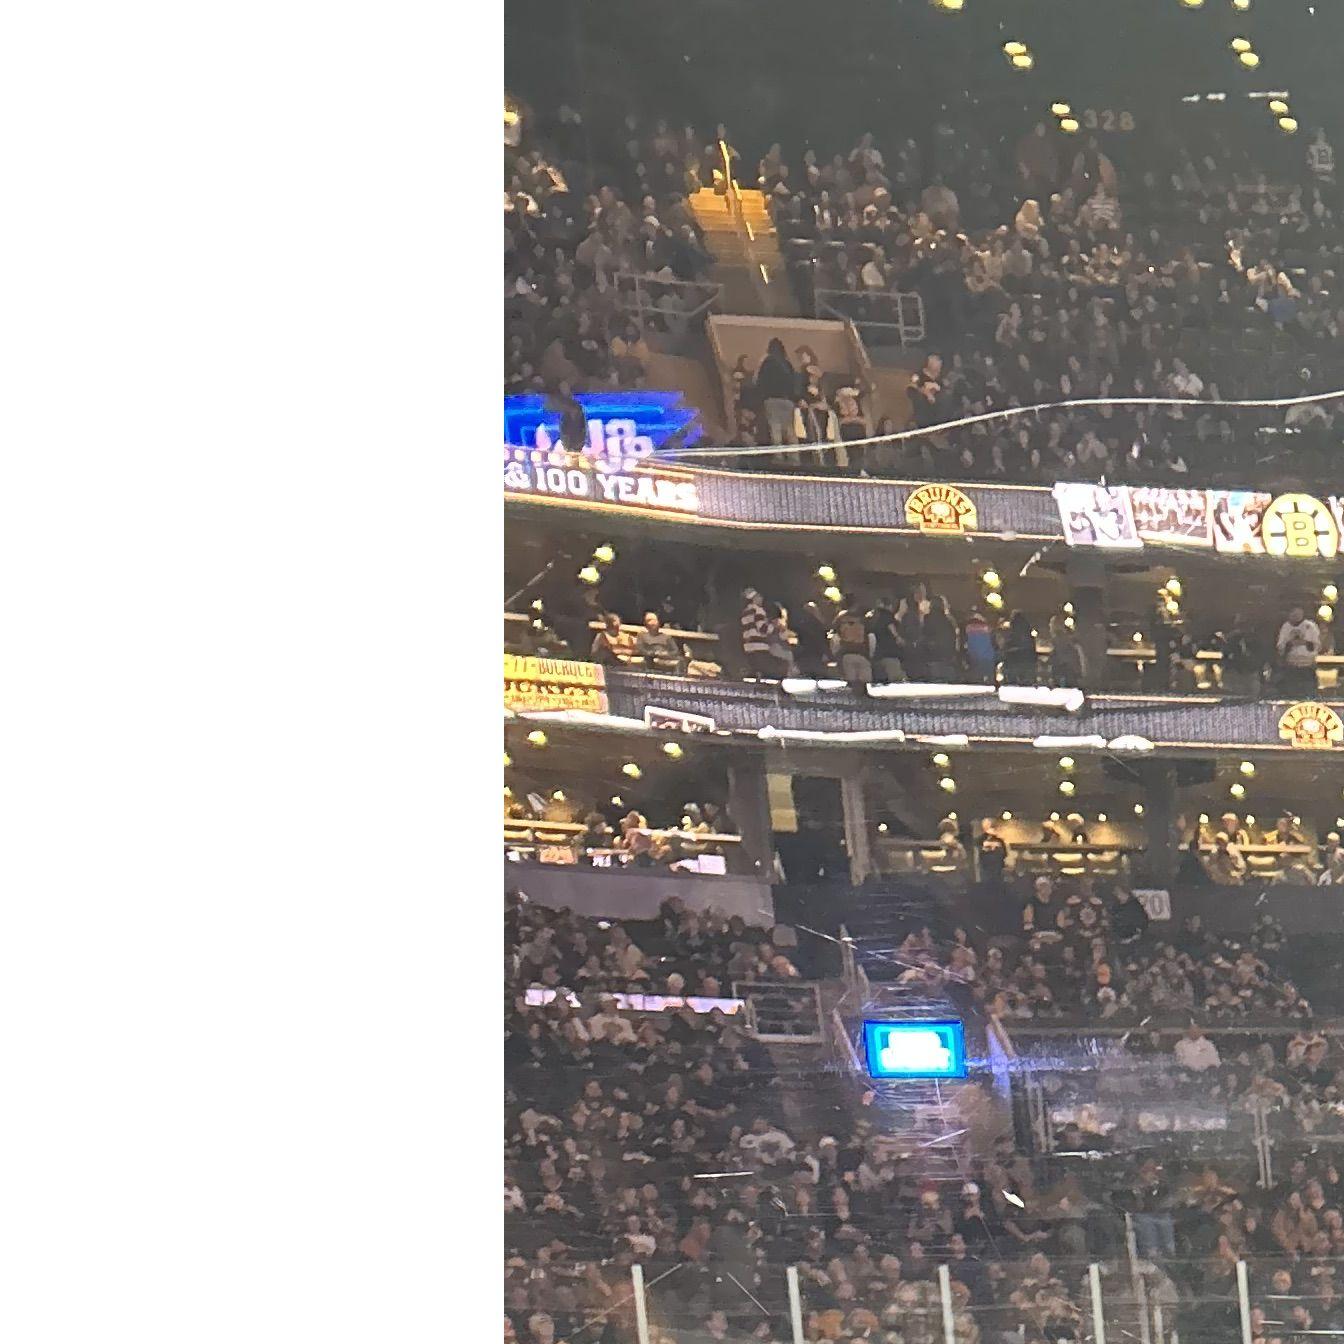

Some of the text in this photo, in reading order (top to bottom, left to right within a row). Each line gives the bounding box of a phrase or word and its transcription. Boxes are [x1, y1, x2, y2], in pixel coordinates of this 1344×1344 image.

[535, 467, 588, 497] 100
[597, 473, 699, 512] YEARS
[909, 487, 972, 514] BRUINS
